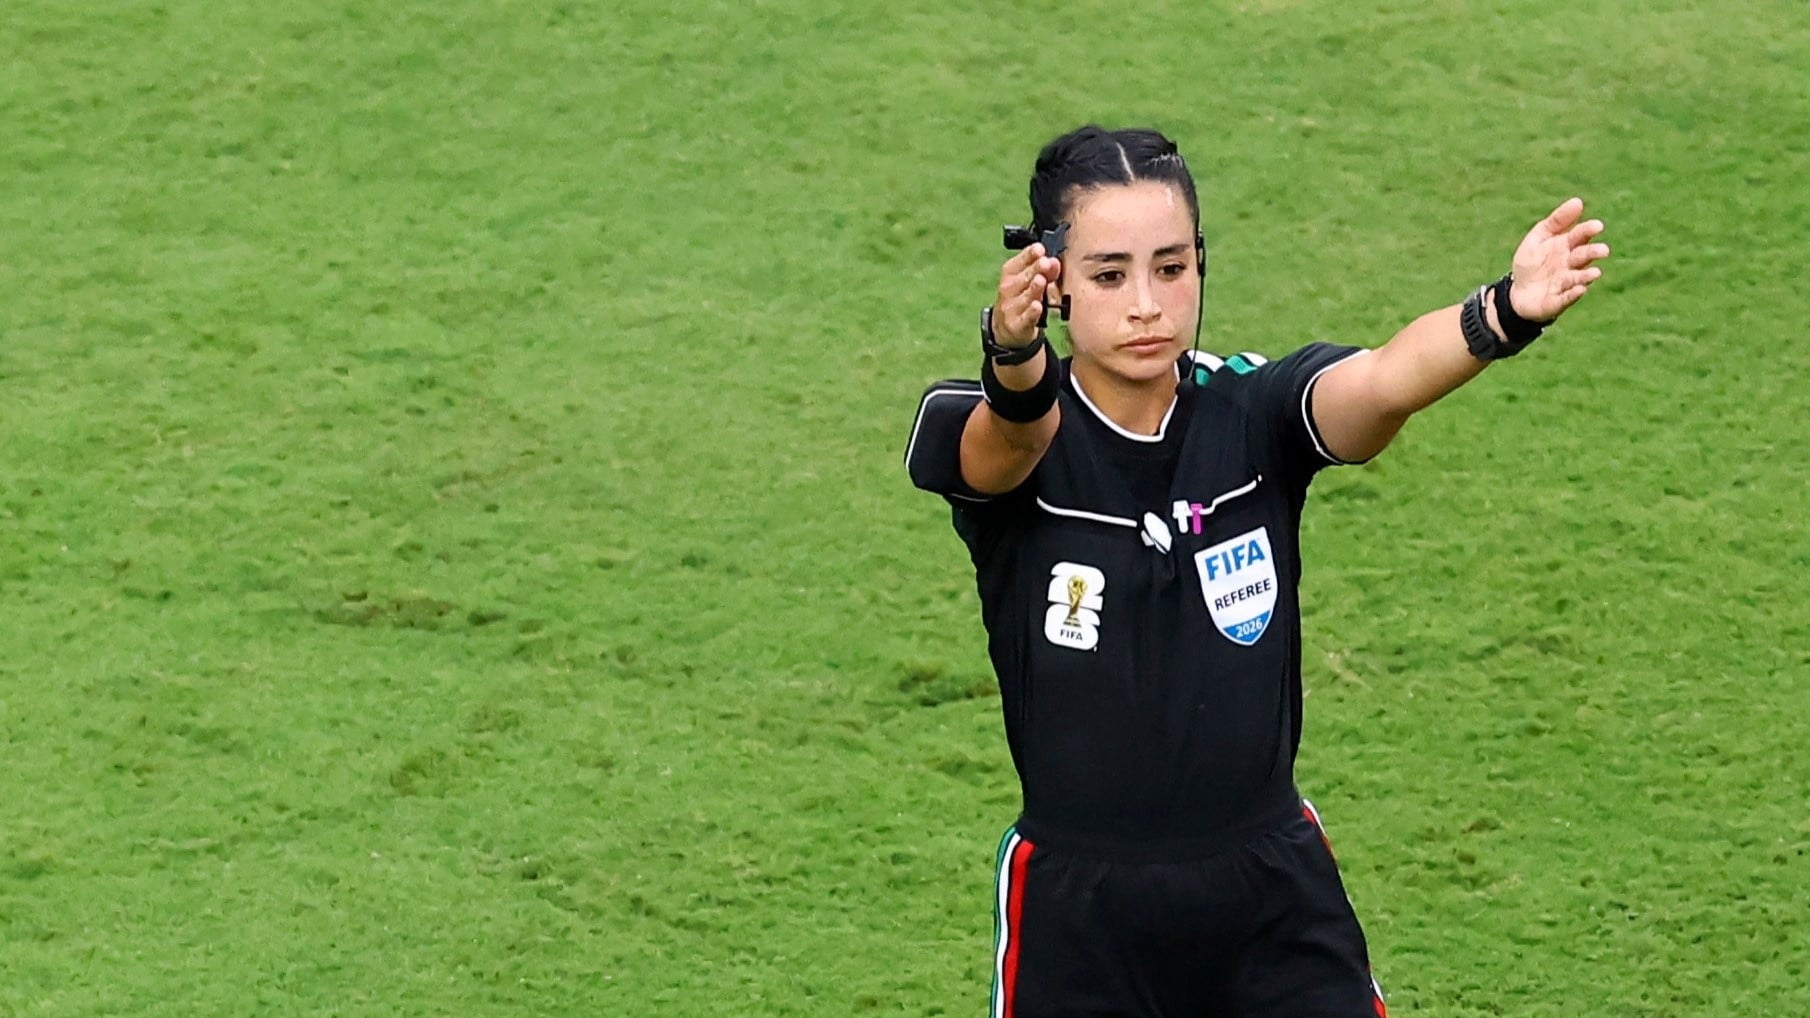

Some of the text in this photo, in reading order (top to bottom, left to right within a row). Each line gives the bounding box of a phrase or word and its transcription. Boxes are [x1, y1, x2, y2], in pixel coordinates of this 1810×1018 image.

[1205, 539, 1266, 581] FIFA
[1214, 578, 1272, 611] REFEREE
[1060, 629, 1083, 641] FIFA
[1236, 618, 1263, 638] 2026
